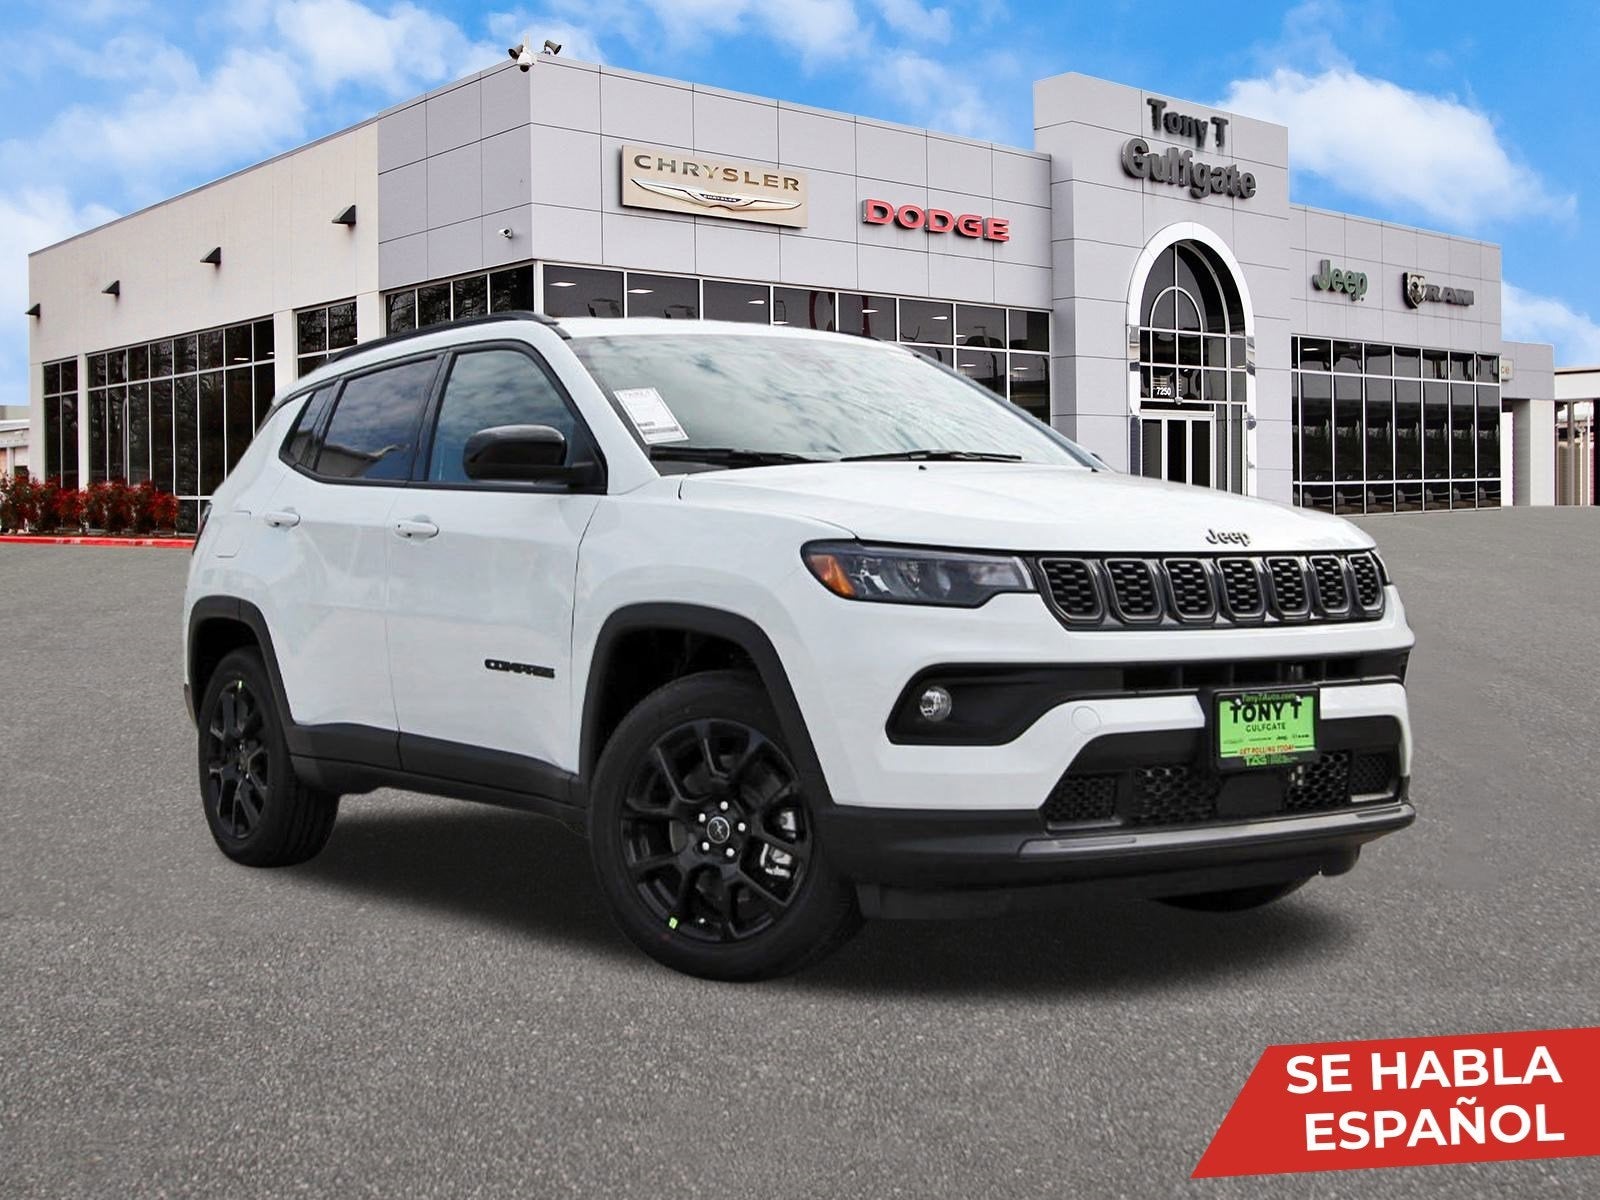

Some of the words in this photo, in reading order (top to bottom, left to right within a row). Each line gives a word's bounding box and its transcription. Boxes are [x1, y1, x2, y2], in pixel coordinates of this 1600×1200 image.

[1146, 97, 1208, 147] Tony
[1210, 116, 1229, 147] T
[633, 153, 801, 193] CHRYSLER
[1121, 137, 1257, 199] Gulfgate
[862, 198, 1011, 243] DODGE
[1312, 259, 1369, 302] Jeep
[1425, 283, 1475, 306] RAM
[1156, 386, 1172, 396] 7250
[1205, 528, 1251, 547] Jeep
[1230, 700, 1285, 723] TONY
[1290, 700, 1302, 719] T
